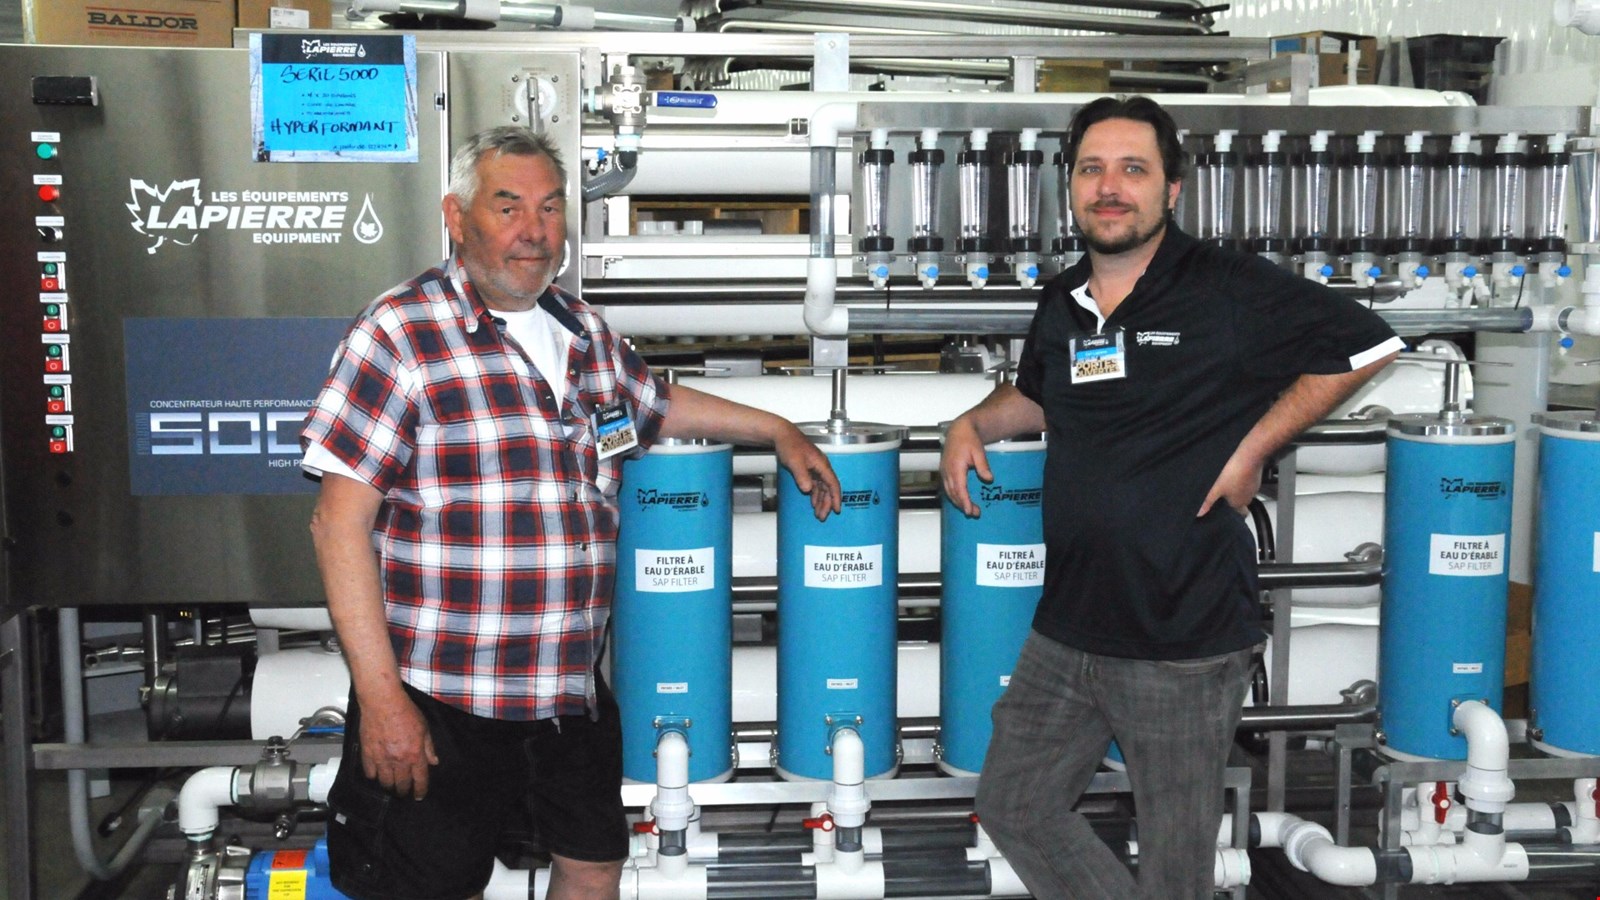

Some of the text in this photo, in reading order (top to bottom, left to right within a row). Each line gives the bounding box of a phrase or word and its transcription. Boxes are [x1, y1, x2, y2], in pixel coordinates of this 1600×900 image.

[88, 12, 198, 30] BALDOR
[306, 45, 357, 54] LAPIERRE
[339, 67, 378, 82] 5000
[211, 189, 349, 203] LES ÉQUIPEMENTS
[146, 205, 347, 230] LAPIERRE
[253, 232, 342, 245] EQUIPMENT
[150, 400, 223, 409] CONCENTRATEUR
[225, 400, 252, 408] HAUTE
[150, 412, 306, 454] 500
[268, 459, 291, 468] HIGH
[642, 495, 699, 504] LAPIERRE
[841, 494, 872, 503] ERRE
[986, 491, 1041, 501] LAPIERRE
[1454, 540, 1490, 550] FILTRE À
[657, 554, 694, 566] FILTRE À
[826, 551, 862, 562] FILTRE À
[999, 550, 1035, 560] FILTRE À
[1440, 551, 1459, 560] EAU
[814, 562, 831, 571] EAU
[986, 561, 1004, 570] EAU
[1448, 561, 1492, 570] SAP FILTER
[645, 567, 661, 576] EAU
[994, 571, 1038, 580] SAP FILTER
[652, 577, 698, 587] SAP FILTER
[822, 573, 867, 583] SAP FILTER
